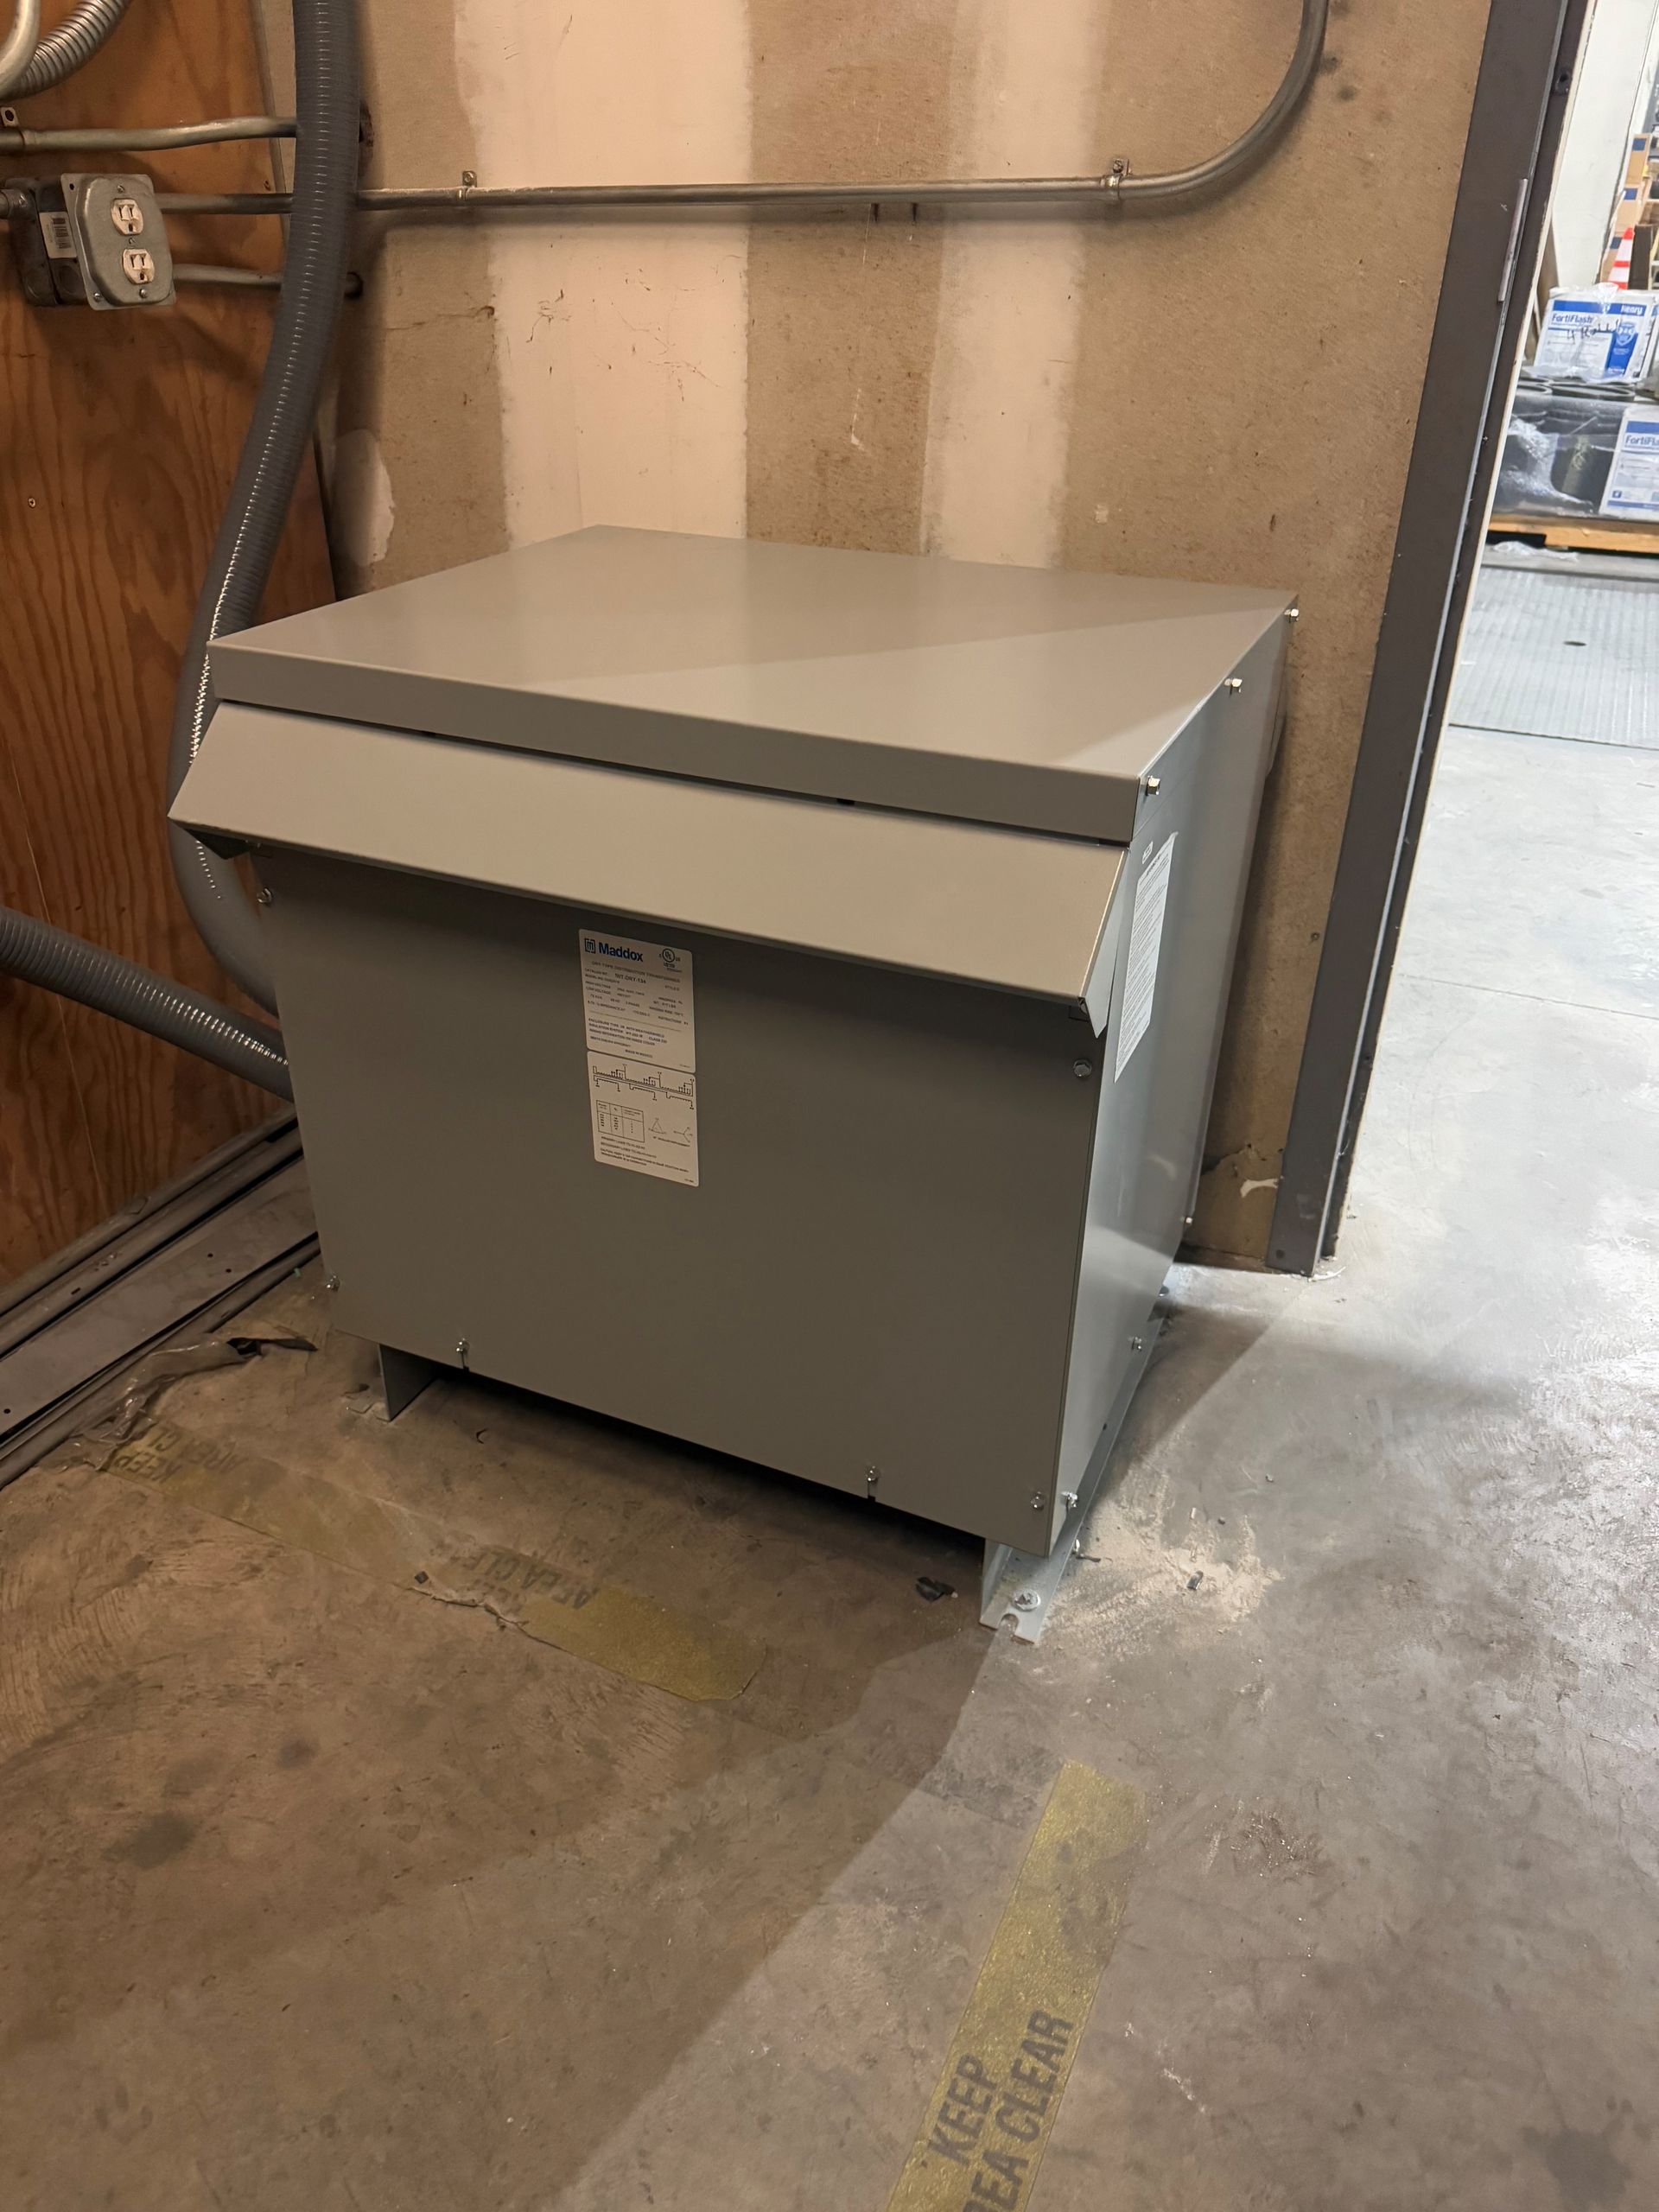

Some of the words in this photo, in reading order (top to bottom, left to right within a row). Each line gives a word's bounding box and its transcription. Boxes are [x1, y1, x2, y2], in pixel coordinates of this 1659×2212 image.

[1552, 314, 1593, 324] FortiFlash
[599, 942, 644, 963] Maddox
[927, 2053, 998, 2167] KEEP
[995, 2010, 1074, 2143] CLEAR
